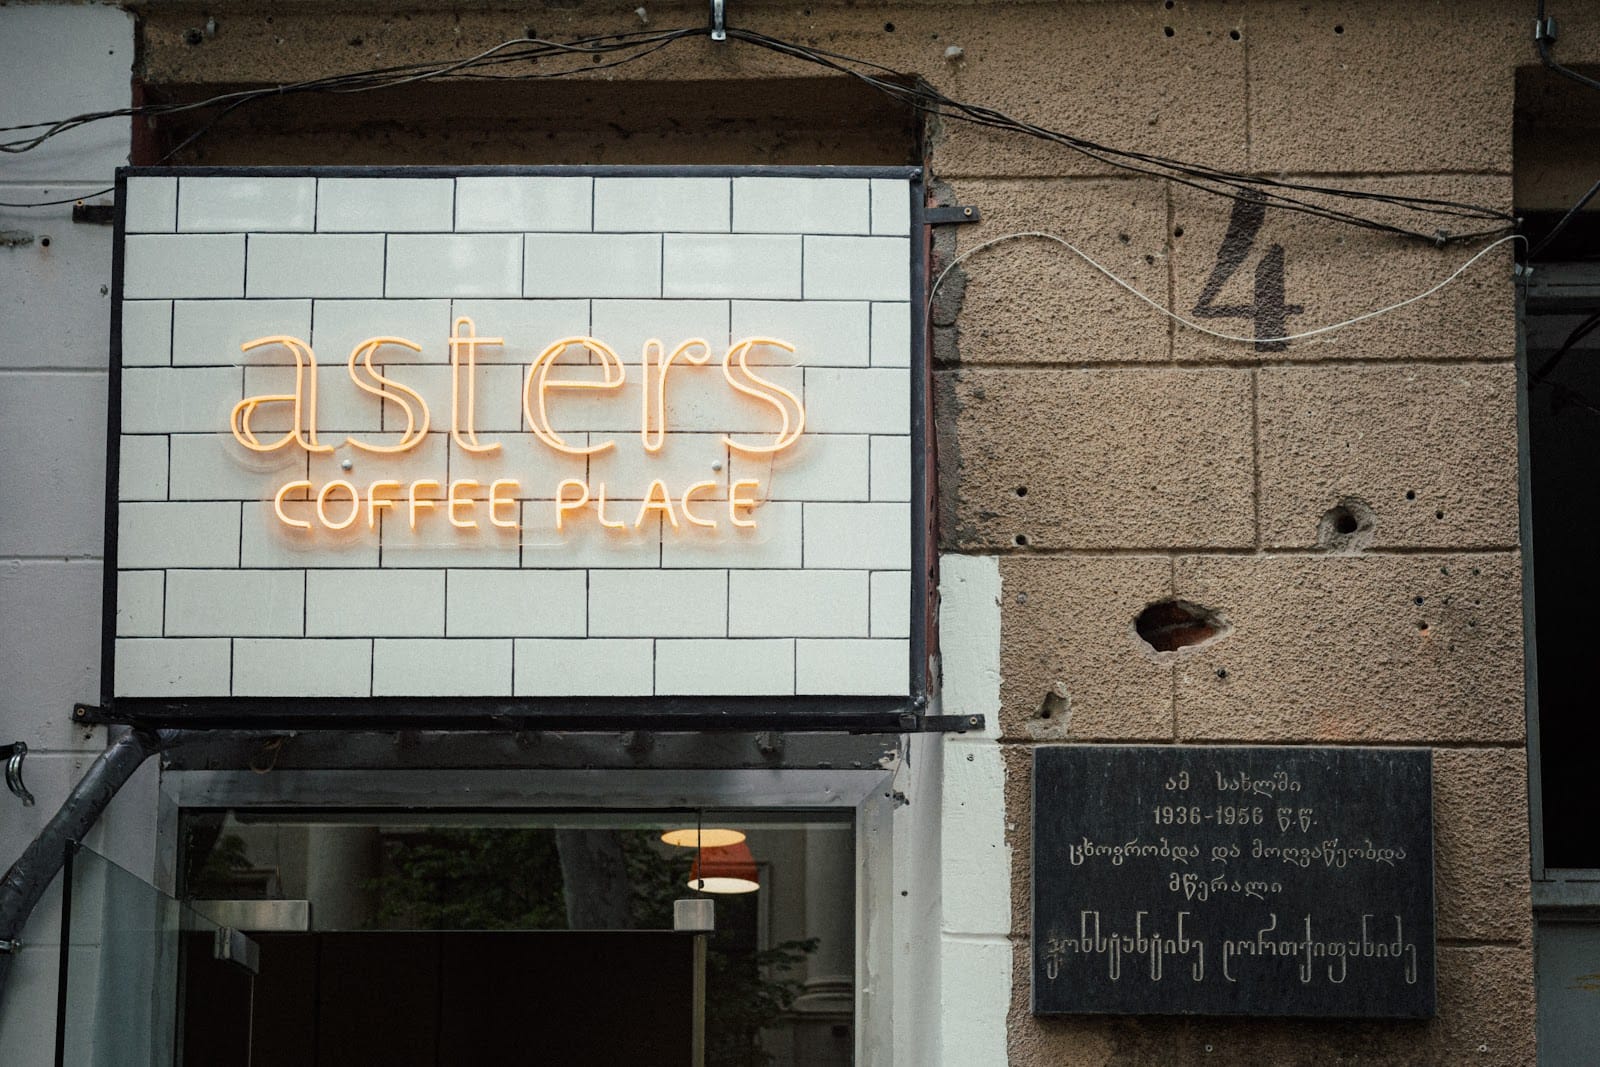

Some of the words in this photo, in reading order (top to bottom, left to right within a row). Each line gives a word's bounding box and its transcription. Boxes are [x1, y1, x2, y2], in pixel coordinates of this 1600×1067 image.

[1192, 188, 1304, 352] 4
[230, 316, 806, 454] asters
[275, 478, 520, 531] COFFEE
[555, 478, 762, 531] PLACE
[1164, 770, 1190, 791] ამ
[1215, 770, 1301, 798] სახლში
[1152, 805, 1264, 825] 1936-1956
[1276, 807, 1318, 833] წ.წ.
[1069, 836, 1200, 866] ცხოვრობდა
[1211, 842, 1241, 864] და
[1251, 838, 1407, 868] მოღვაწეობდა
[1168, 872, 1283, 901] მწერალი
[1223, 912, 1417, 984] ლორთქიფანიძე
